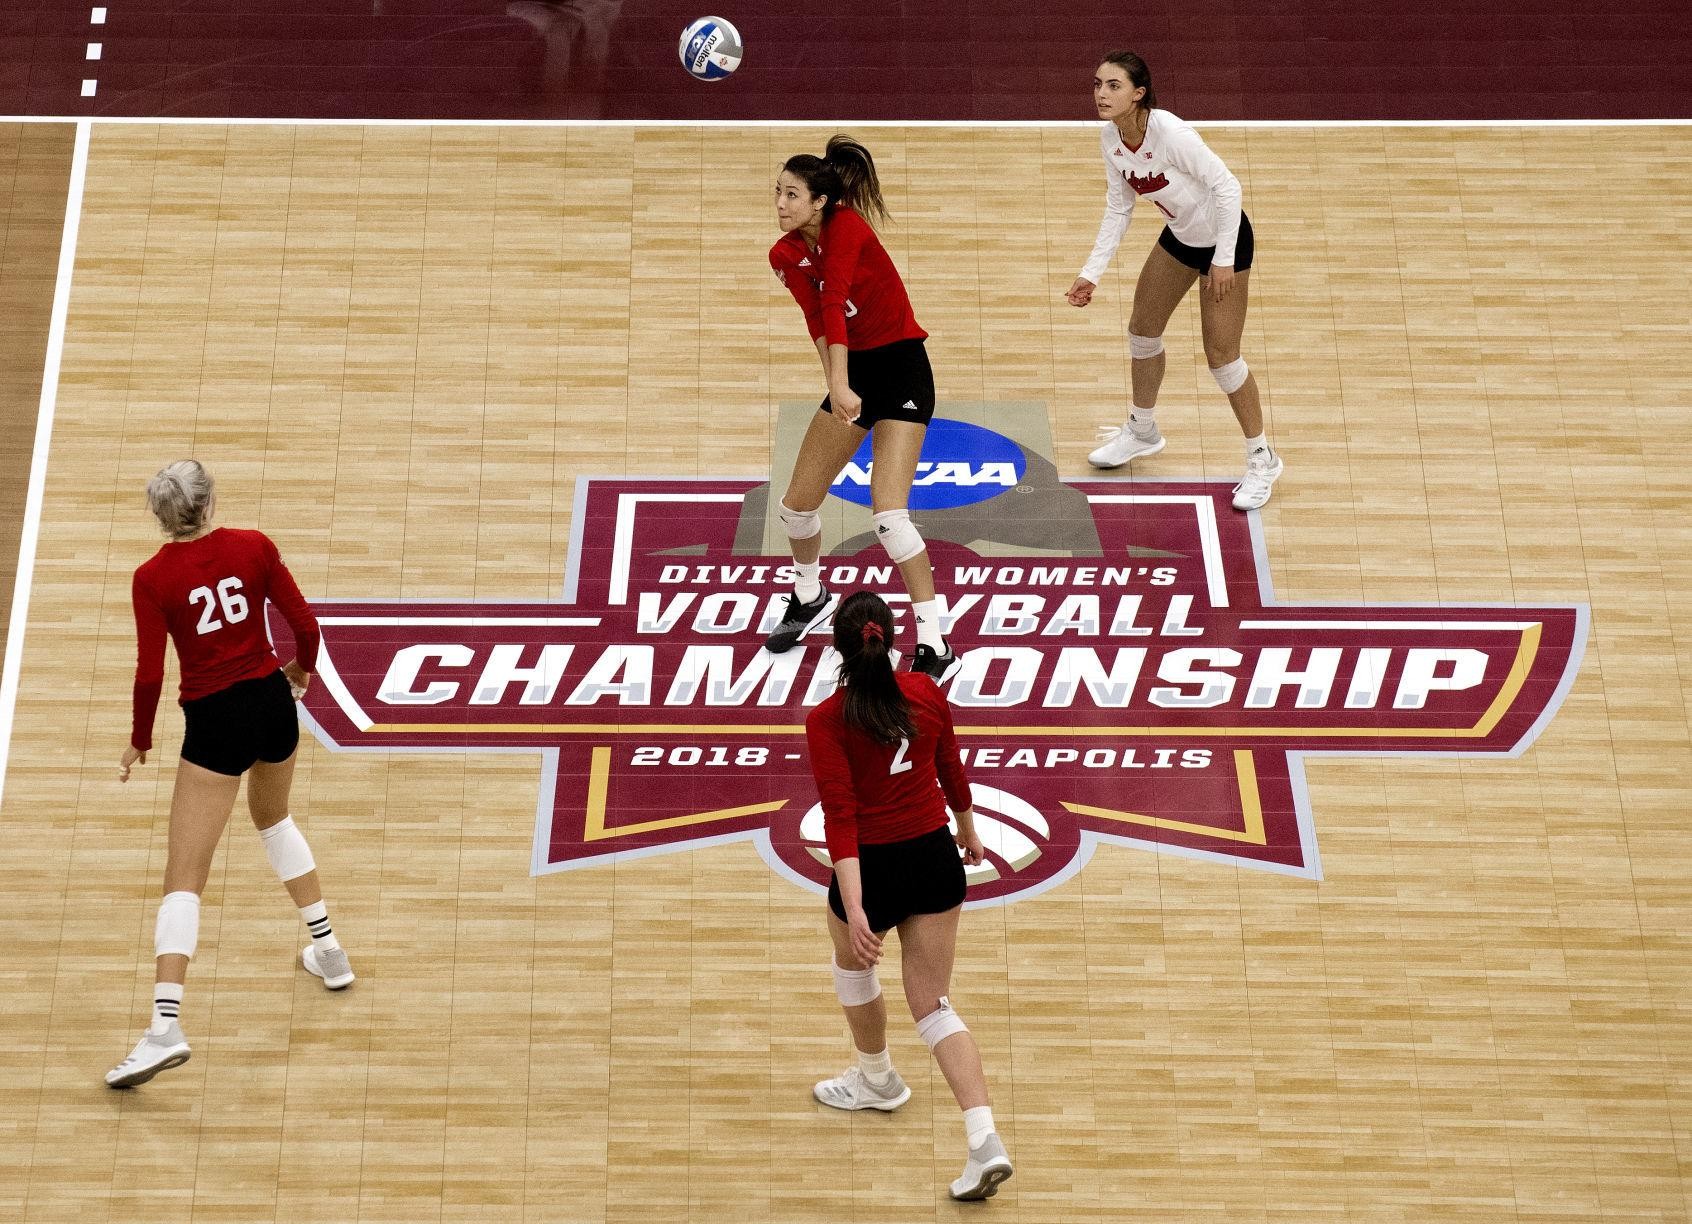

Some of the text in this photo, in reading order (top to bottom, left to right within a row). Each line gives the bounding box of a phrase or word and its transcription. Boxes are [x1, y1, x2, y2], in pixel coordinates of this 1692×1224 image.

[695, 34, 717, 68] molten
[659, 565, 894, 584] DIVISON
[954, 566, 1178, 586] WOMEN'S
[188, 575, 249, 636] 26
[637, 592, 1204, 636] VOLYBALL
[375, 643, 1490, 709] CHAMONSHIP
[630, 746, 770, 767] 2018
[960, 748, 1213, 768] EAPOLIS
[889, 737, 913, 775] 2
